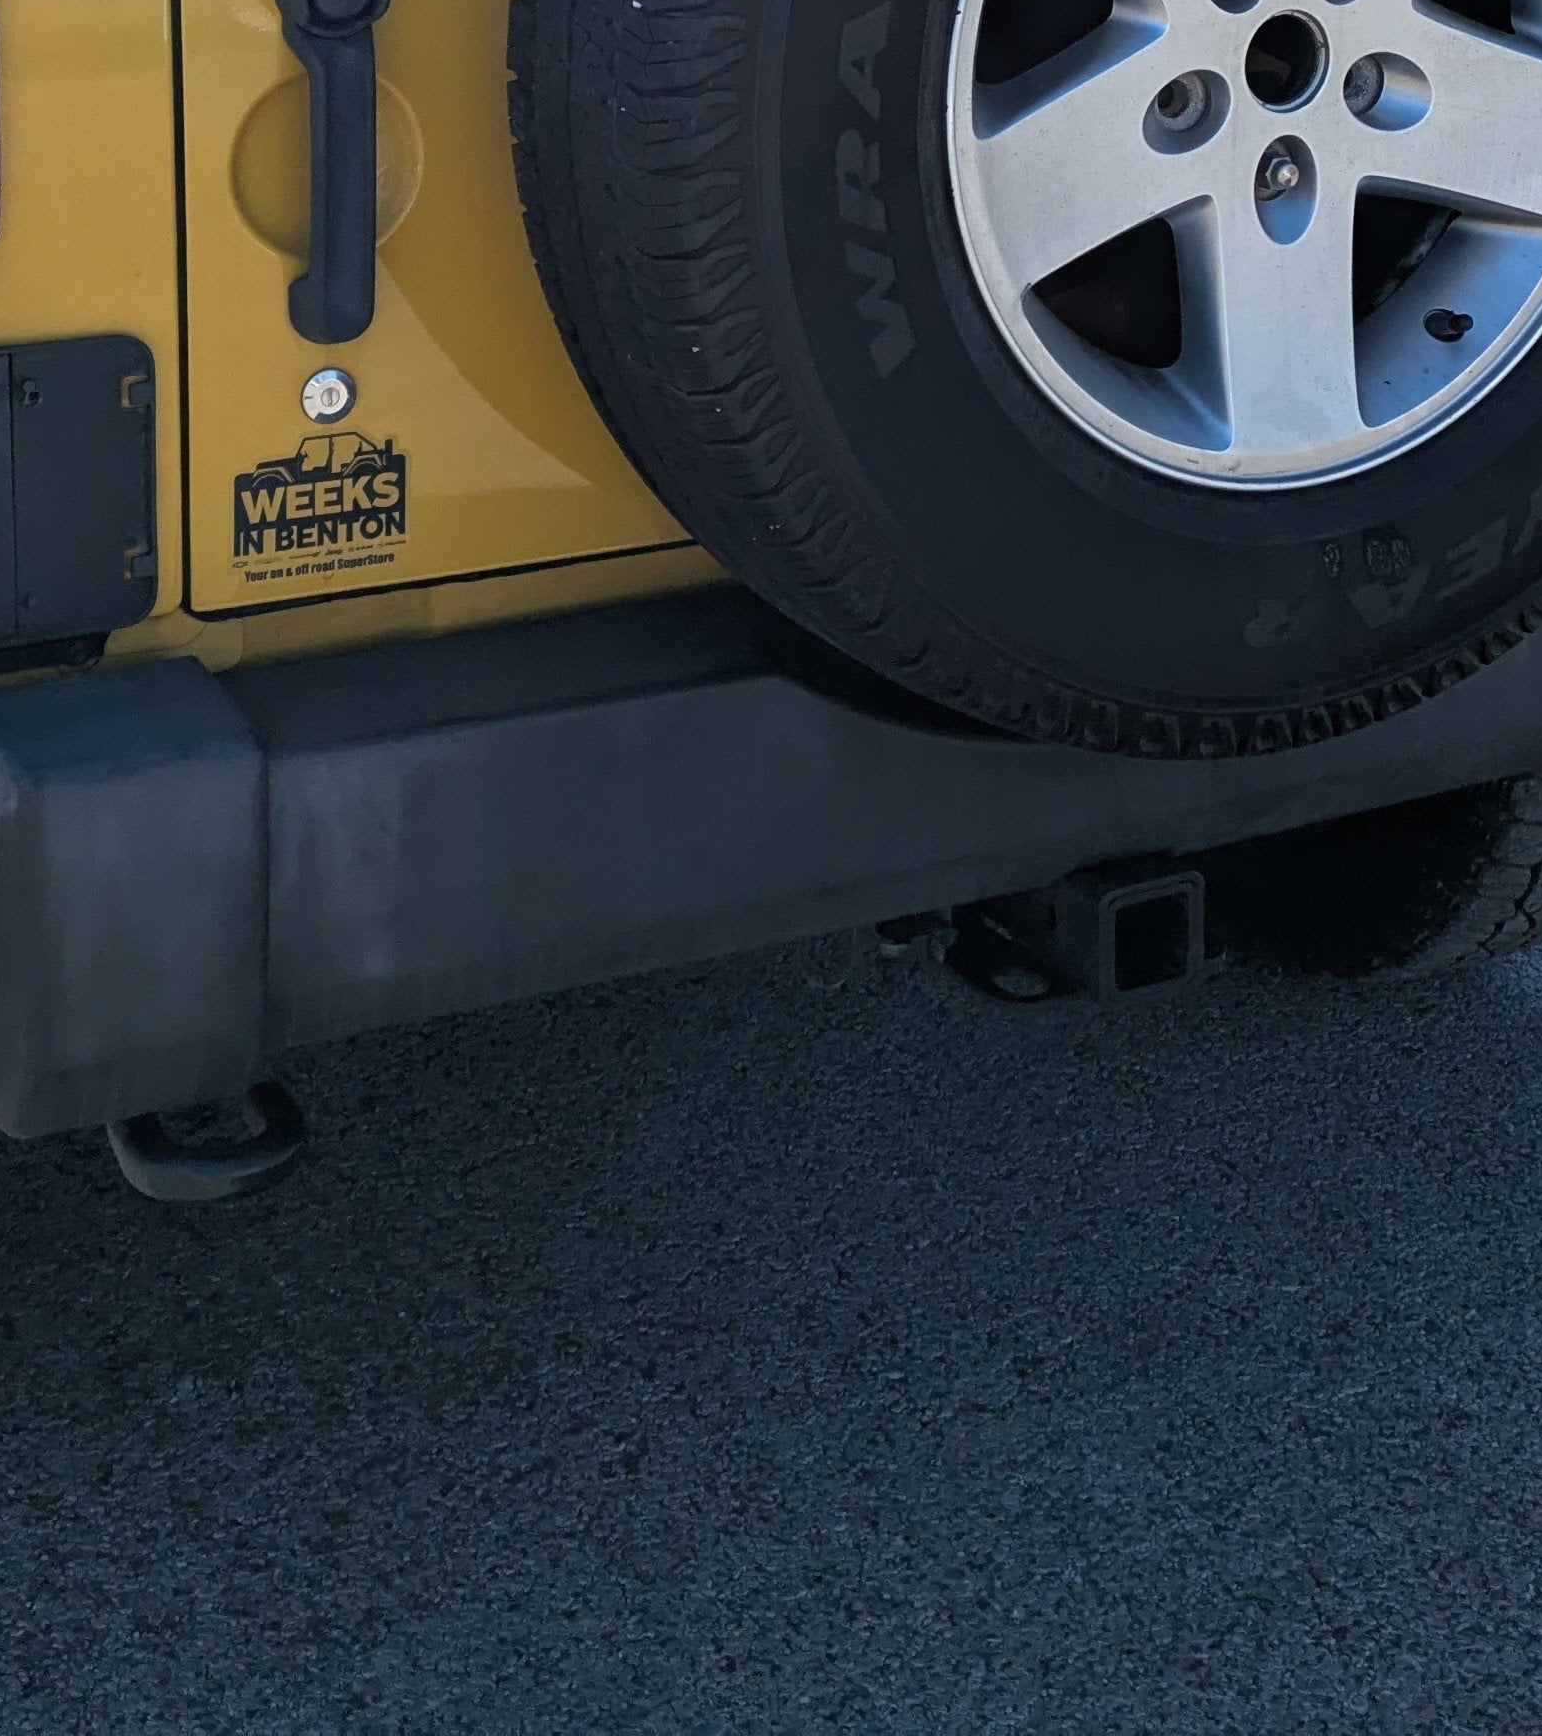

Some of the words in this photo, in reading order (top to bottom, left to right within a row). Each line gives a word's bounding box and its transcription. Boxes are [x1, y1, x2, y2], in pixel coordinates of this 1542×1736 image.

[240, 471, 401, 525] WEEKS
[274, 511, 407, 552] BENTON
[244, 569, 268, 583] Your
[270, 568, 284, 579] on
[285, 568, 294, 578] &
[295, 564, 309, 576] off
[310, 559, 335, 574] road
